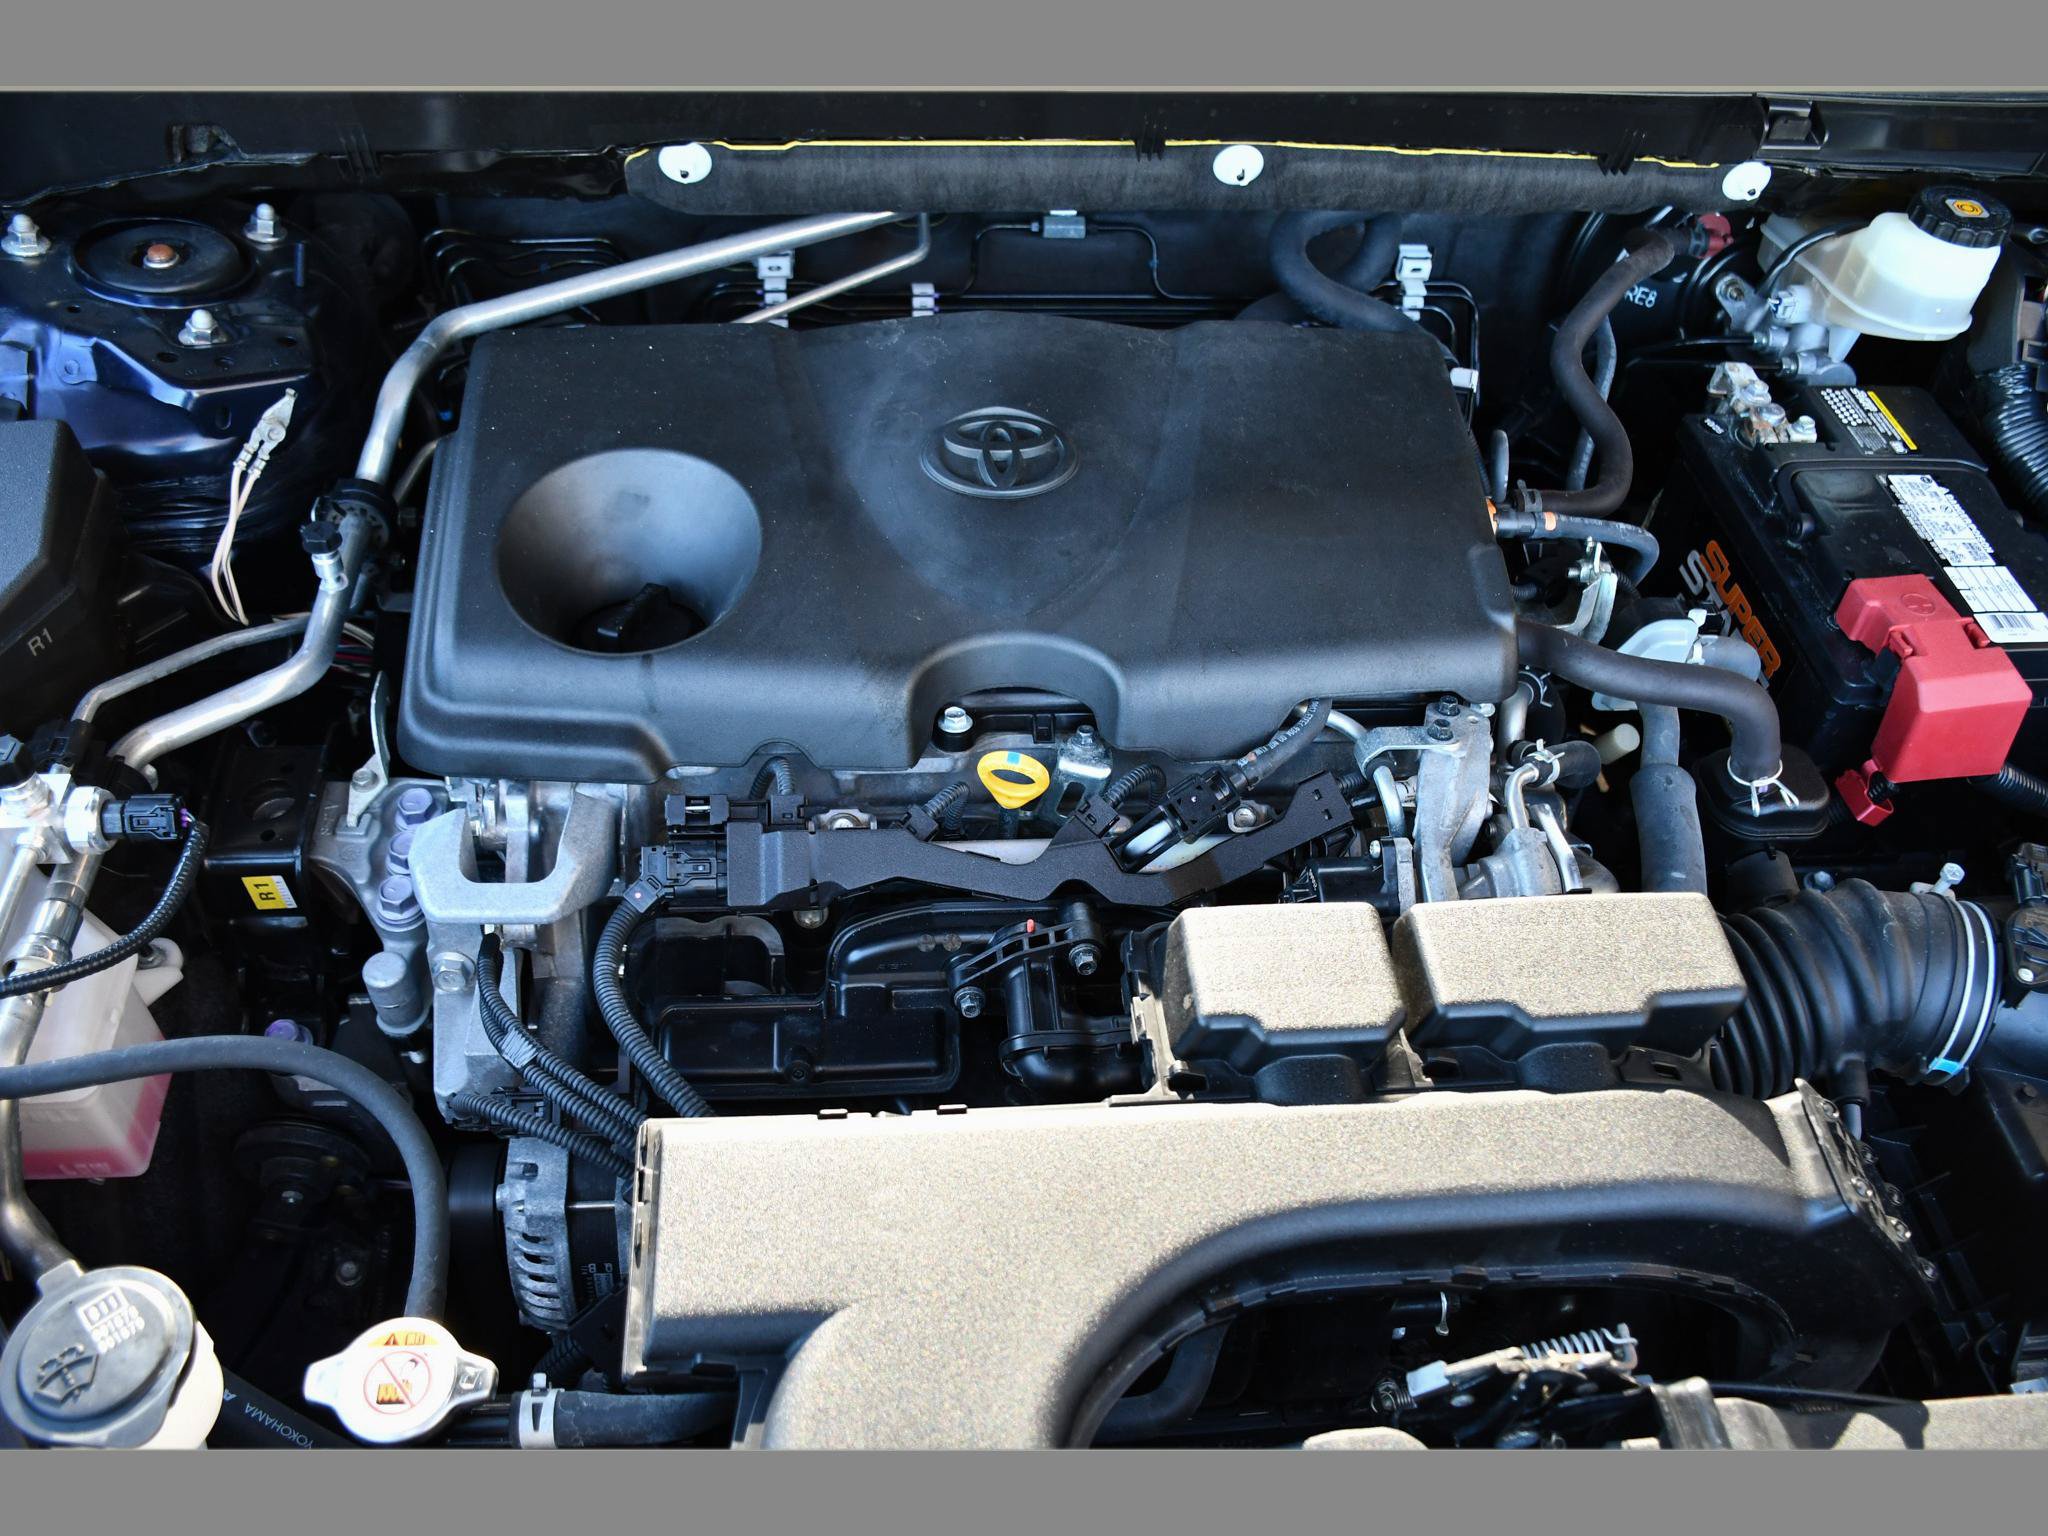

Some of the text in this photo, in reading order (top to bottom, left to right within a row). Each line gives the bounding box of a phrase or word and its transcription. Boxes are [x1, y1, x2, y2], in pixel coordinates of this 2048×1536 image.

[1700, 539, 1782, 680] SUPER
[27, 627, 53, 657] R1
[253, 883, 277, 901] R1
[244, 1402, 315, 1450] YOKOHAMA
